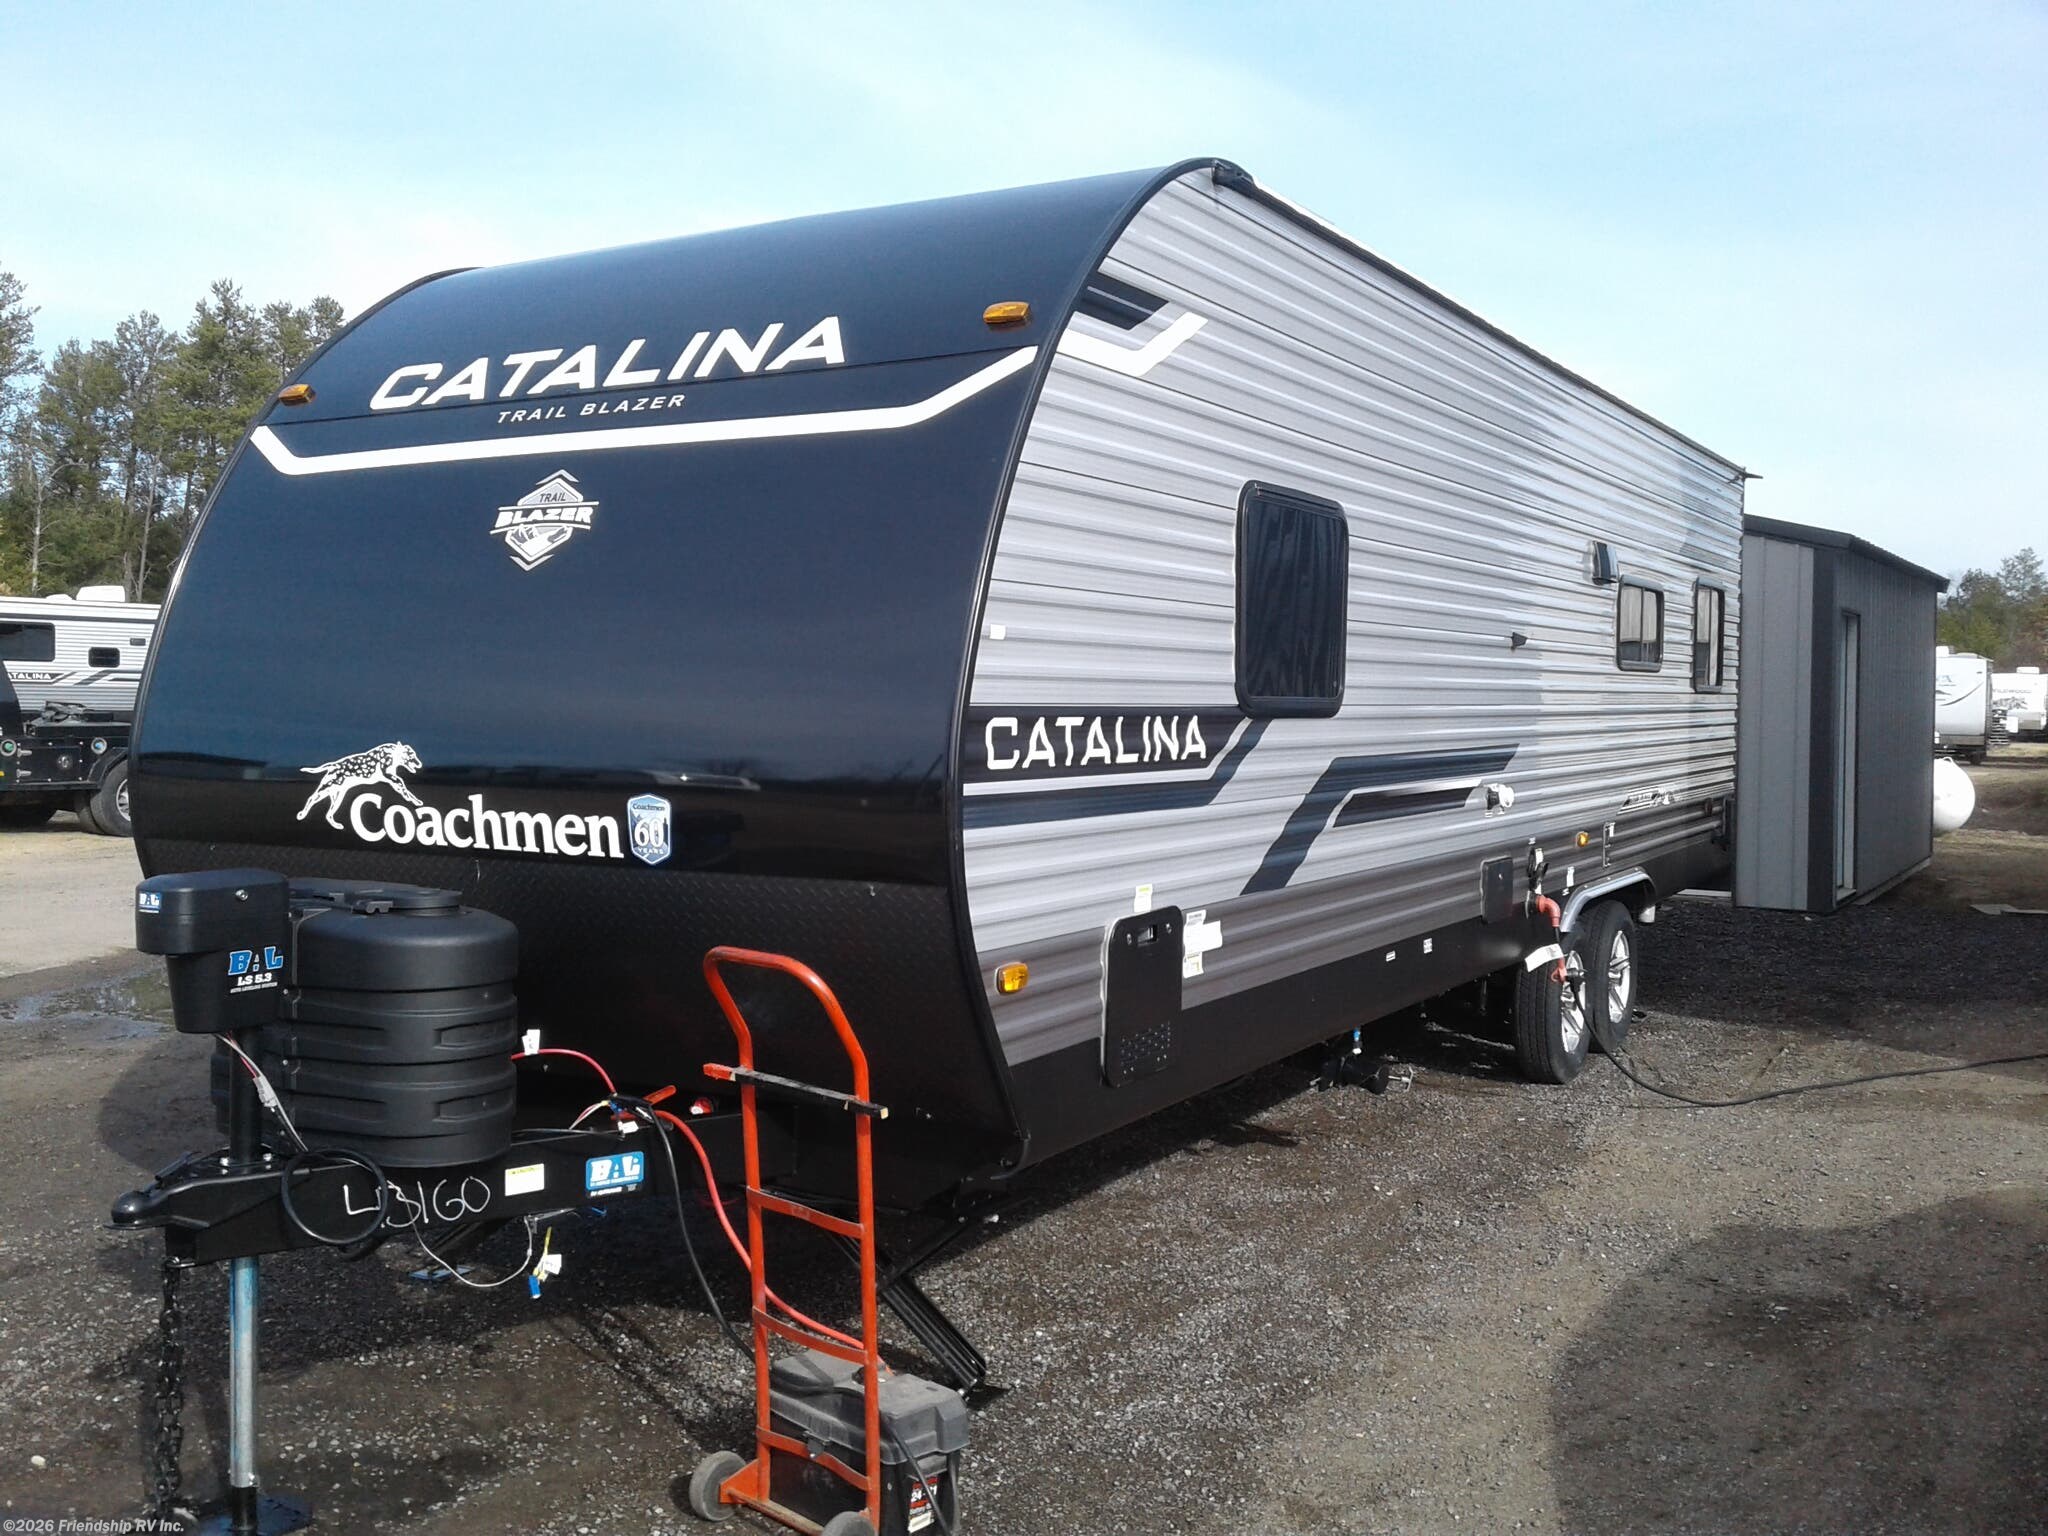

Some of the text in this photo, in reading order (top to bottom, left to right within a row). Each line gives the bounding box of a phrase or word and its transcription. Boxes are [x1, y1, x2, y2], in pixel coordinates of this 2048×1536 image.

[368, 315, 846, 411] CATALINA
[497, 394, 686, 424] TRAIL BLAZER
[540, 491, 566, 503] TRAIL
[494, 506, 594, 528] BLAZER
[985, 715, 1207, 770] CATALINA
[350, 793, 625, 859] Coachmen
[634, 817, 665, 848] 60
[237, 972, 273, 987] LS 5.3
